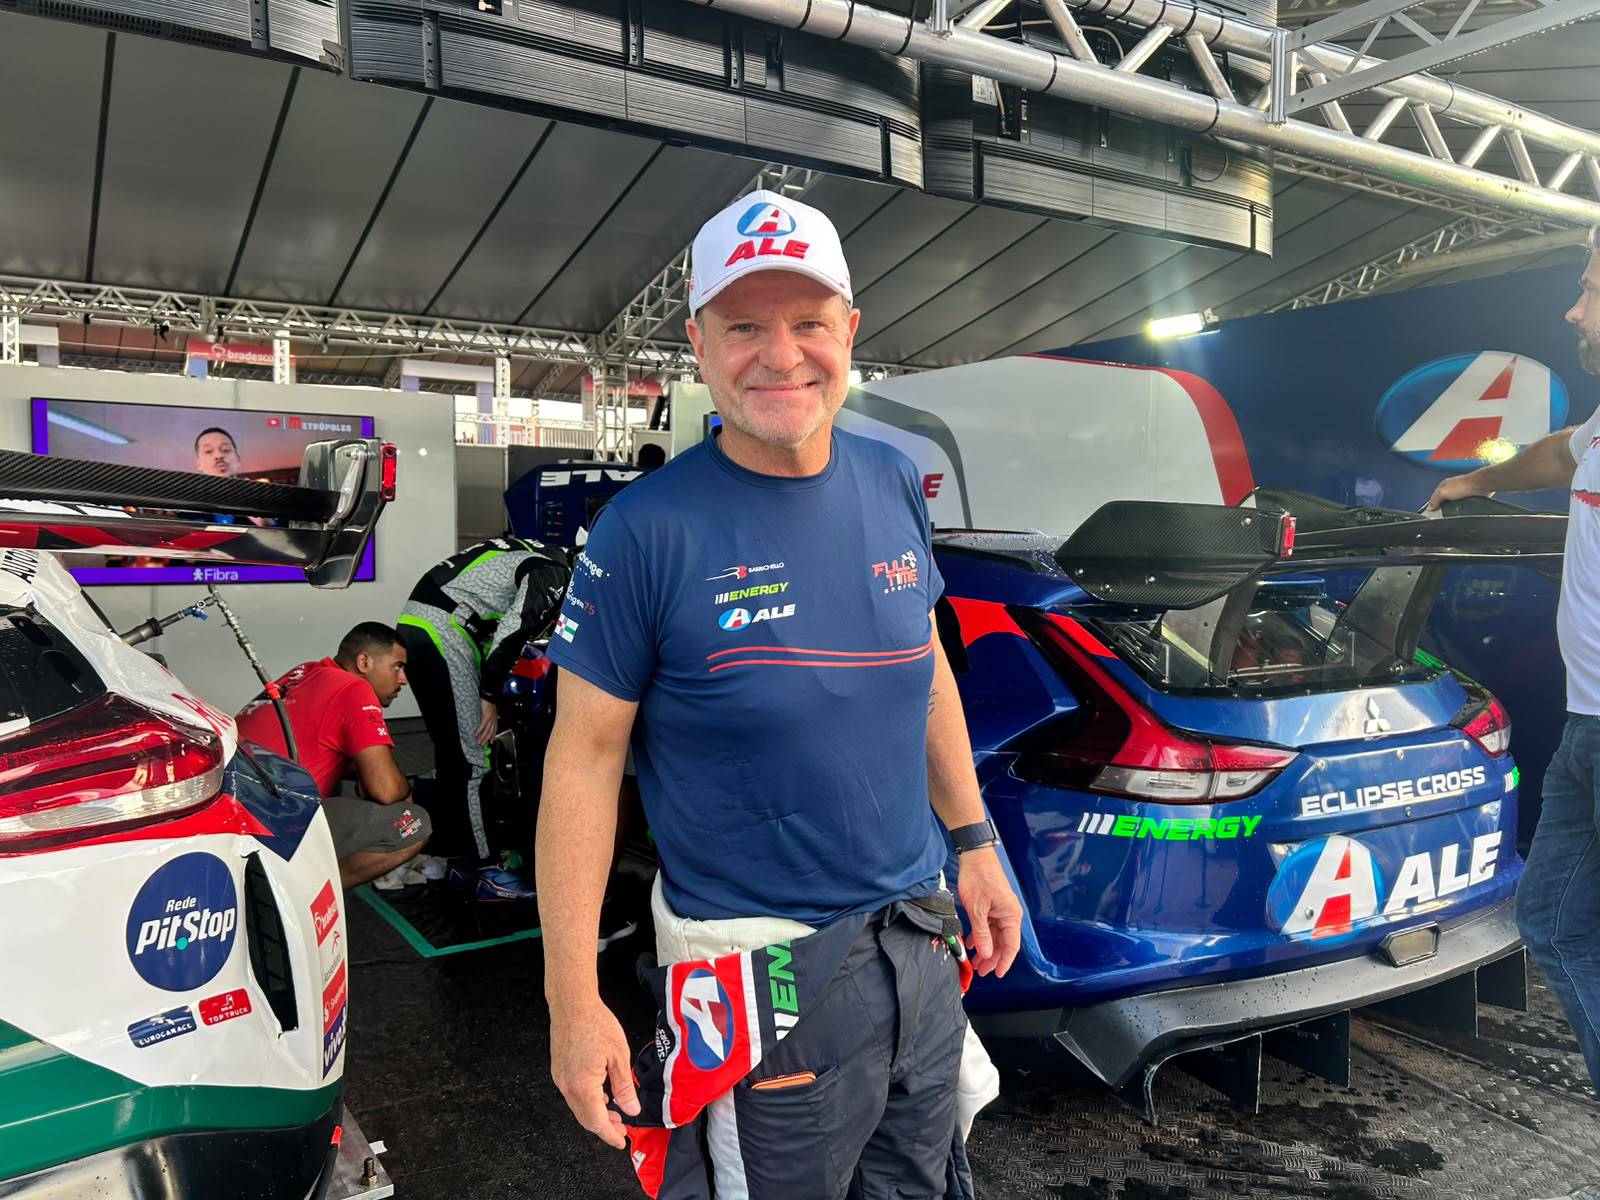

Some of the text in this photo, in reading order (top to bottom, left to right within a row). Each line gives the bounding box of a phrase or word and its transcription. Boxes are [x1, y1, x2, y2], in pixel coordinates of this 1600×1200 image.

[725, 238, 810, 267] ALE
[204, 568, 239, 582] Fibra
[886, 568, 918, 588] TIME
[751, 604, 796, 624] ALE
[1300, 780, 1412, 817] ECLIPSE
[1417, 765, 1486, 798] CROSS
[1112, 814, 1262, 842] ENERGY
[1383, 831, 1503, 914] ALE
[165, 896, 197, 913] Rede
[208, 1008, 248, 1024] TOP TRUCK
